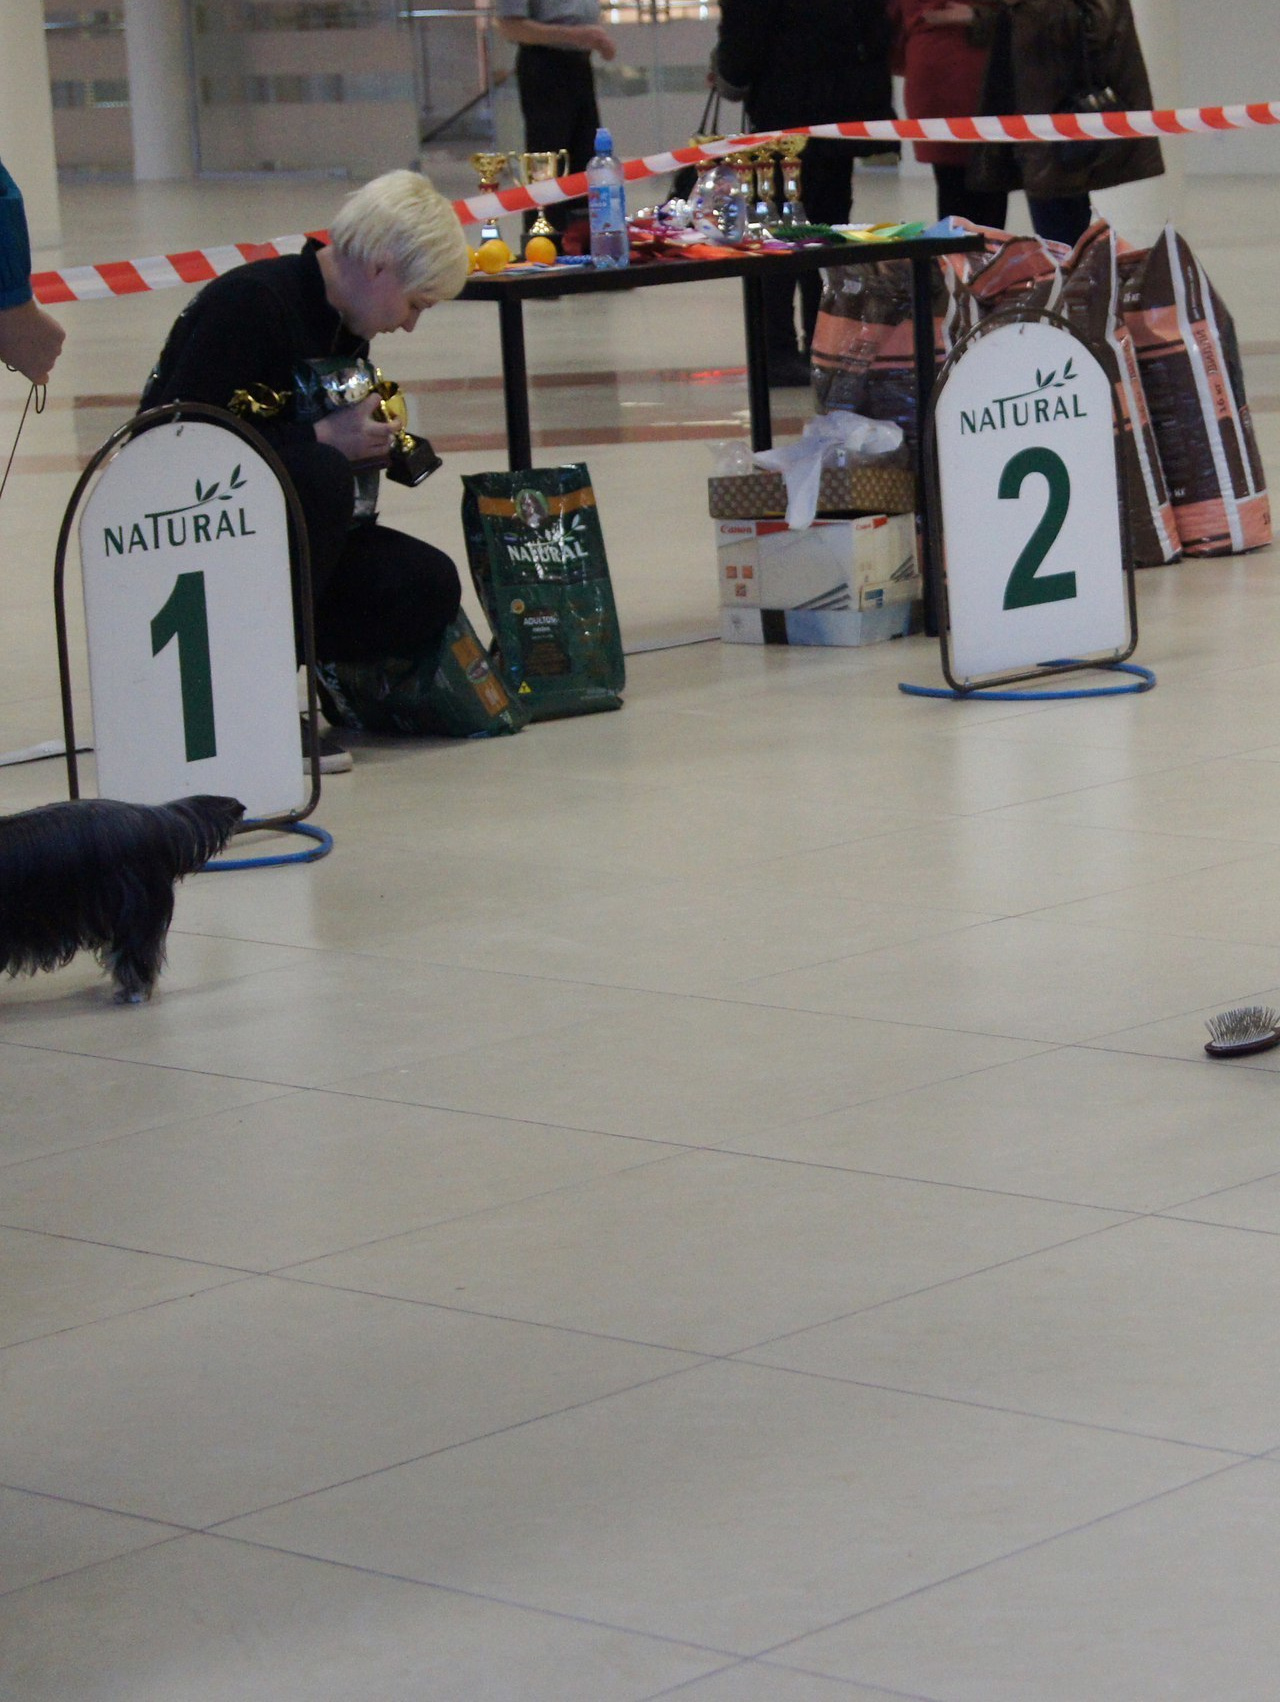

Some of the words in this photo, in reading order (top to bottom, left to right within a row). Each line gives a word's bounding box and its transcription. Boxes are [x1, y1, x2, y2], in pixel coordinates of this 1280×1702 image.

[960, 393, 1088, 435] NATURAL
[103, 507, 257, 557] NATURAL
[720, 524, 752, 534] Canon
[997, 446, 1078, 611] 2
[506, 541, 589, 564] NATURAL
[150, 570, 217, 763] 1
